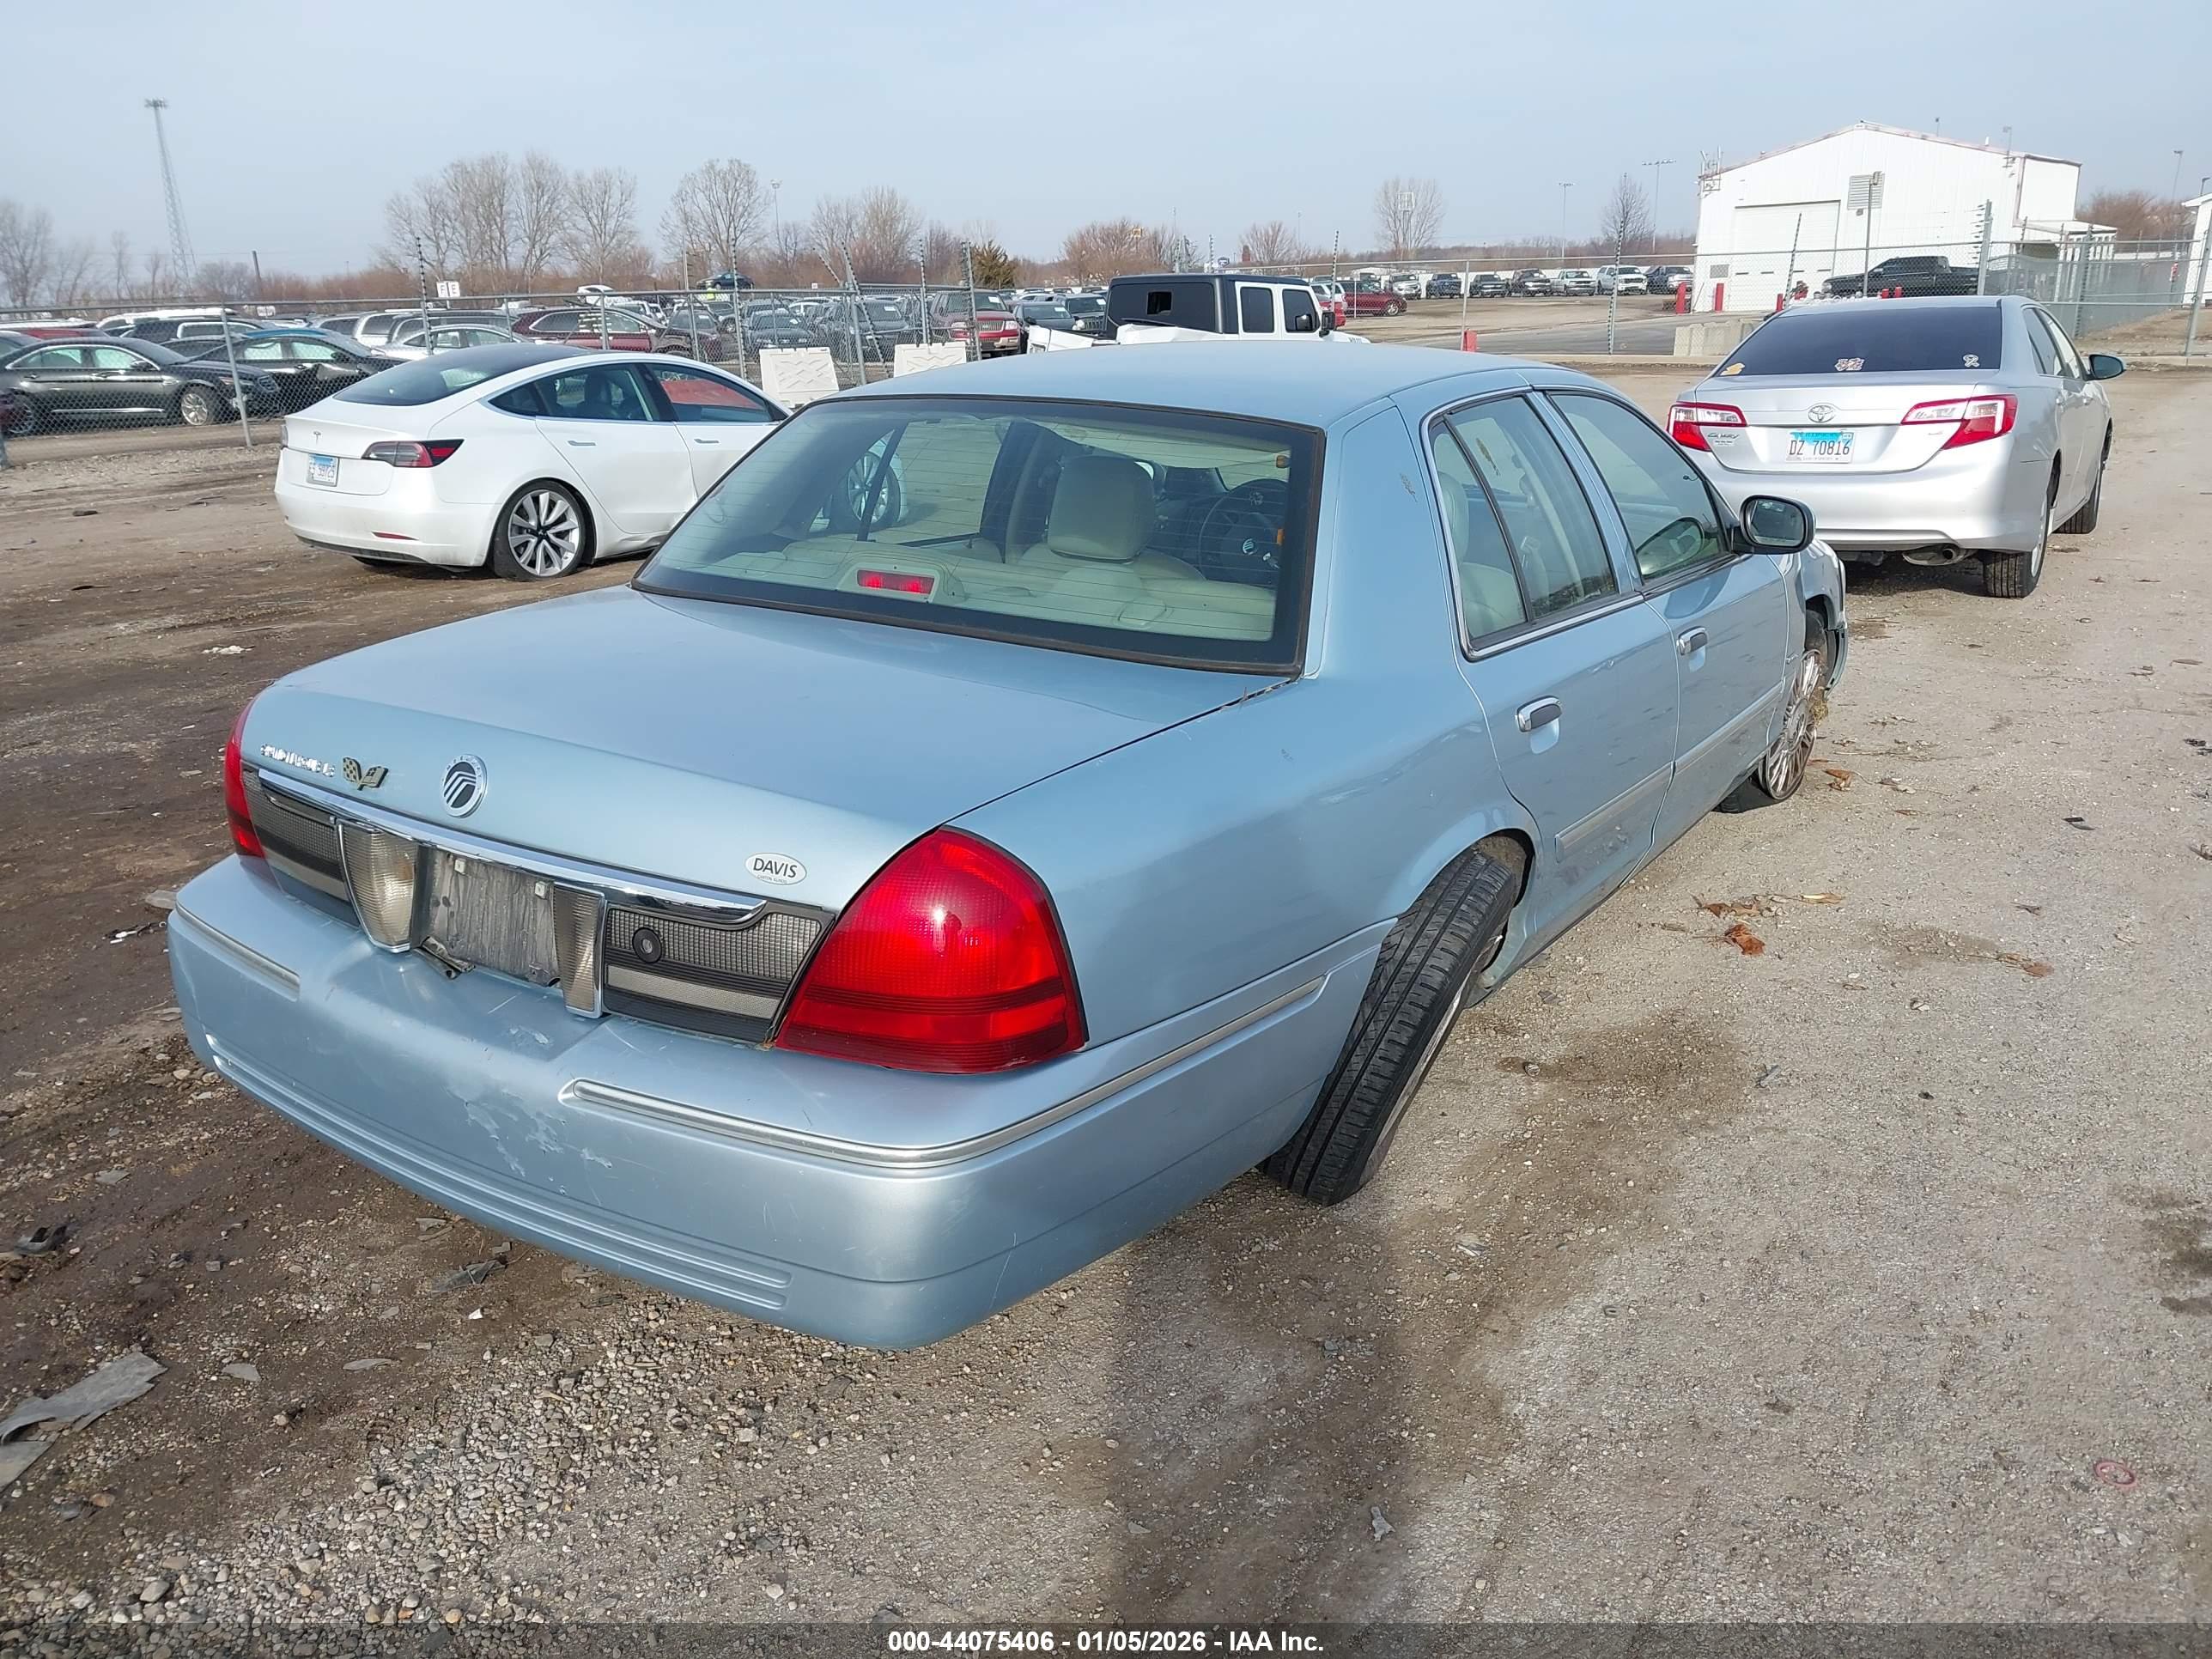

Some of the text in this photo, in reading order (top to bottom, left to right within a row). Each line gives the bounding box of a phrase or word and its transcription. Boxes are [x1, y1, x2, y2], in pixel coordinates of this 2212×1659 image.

[1789, 440, 1850, 455] DZ 70816
[753, 857, 797, 878] DAVIS
